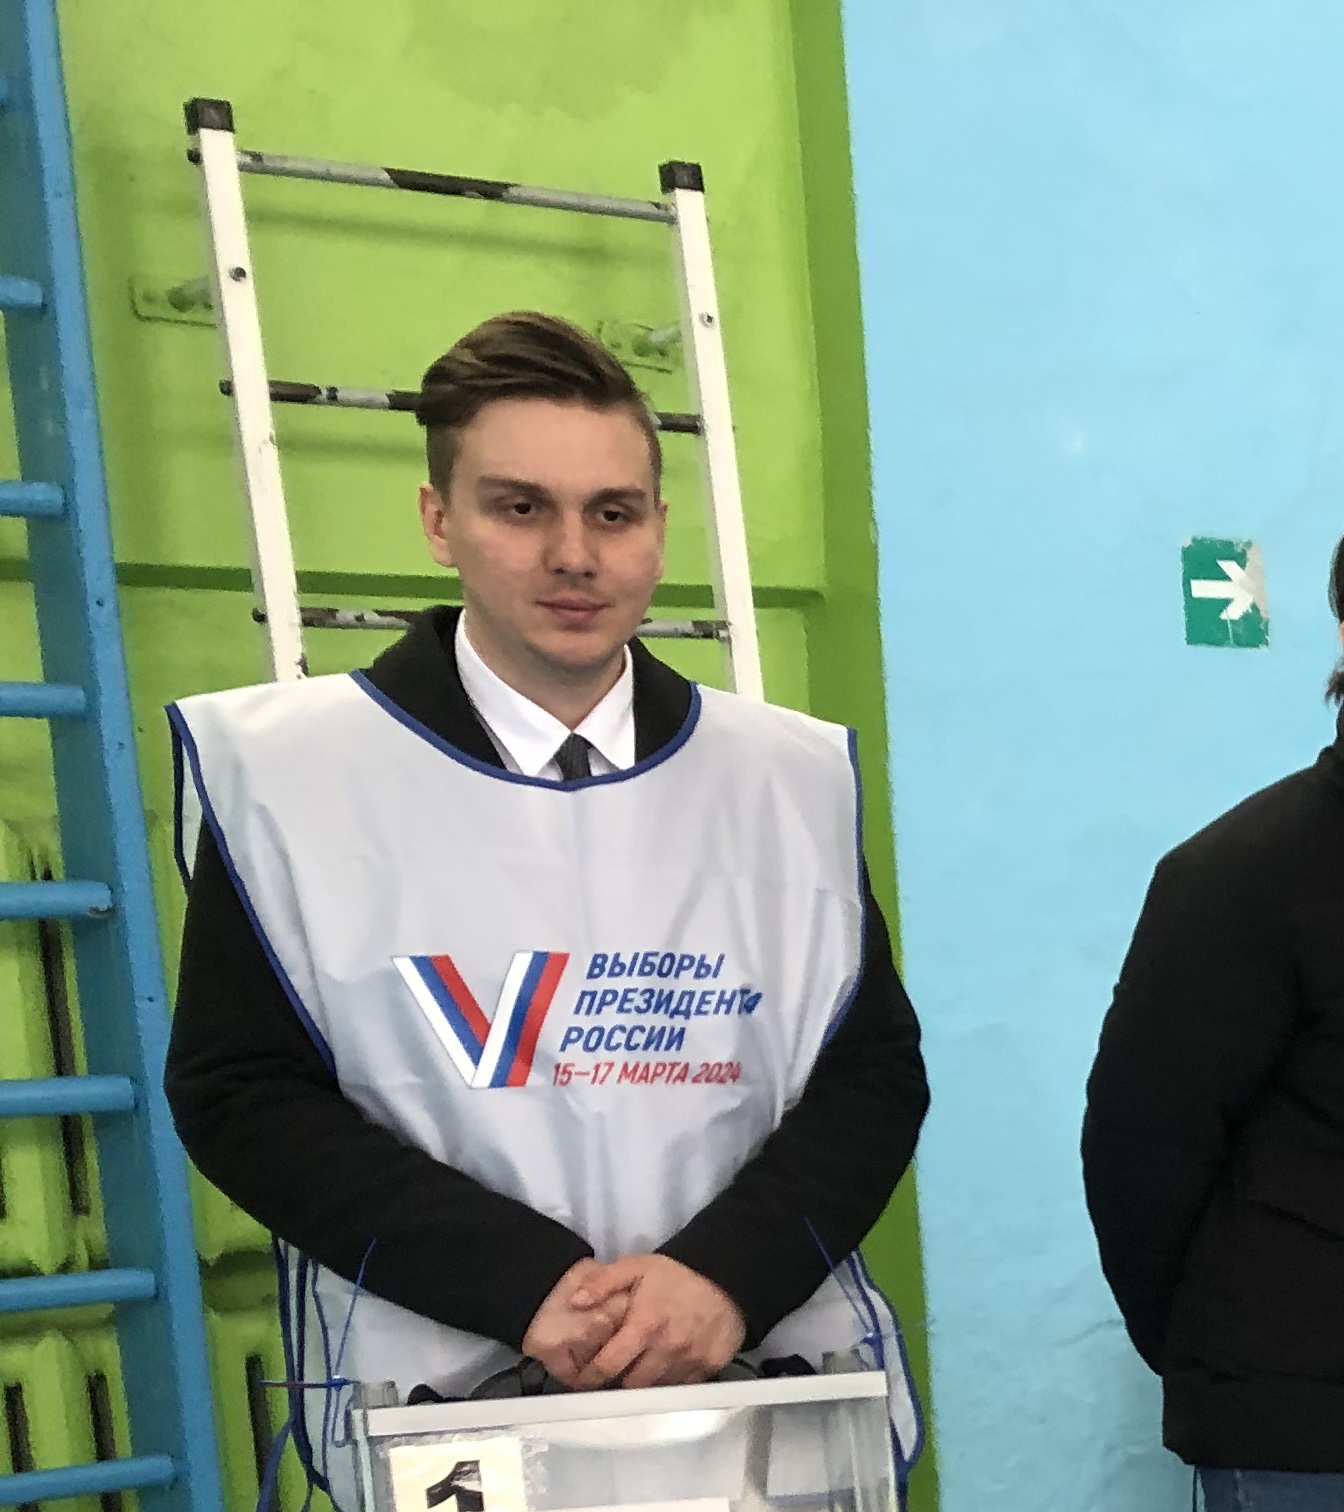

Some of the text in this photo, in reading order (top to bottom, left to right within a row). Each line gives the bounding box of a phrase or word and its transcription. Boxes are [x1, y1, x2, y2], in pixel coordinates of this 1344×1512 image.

[585, 952, 725, 980] ВЫБОРЫ
[559, 1025, 686, 1053] РОССИИ
[552, 1061, 742, 1087] 15–17 МАРТА 2024
